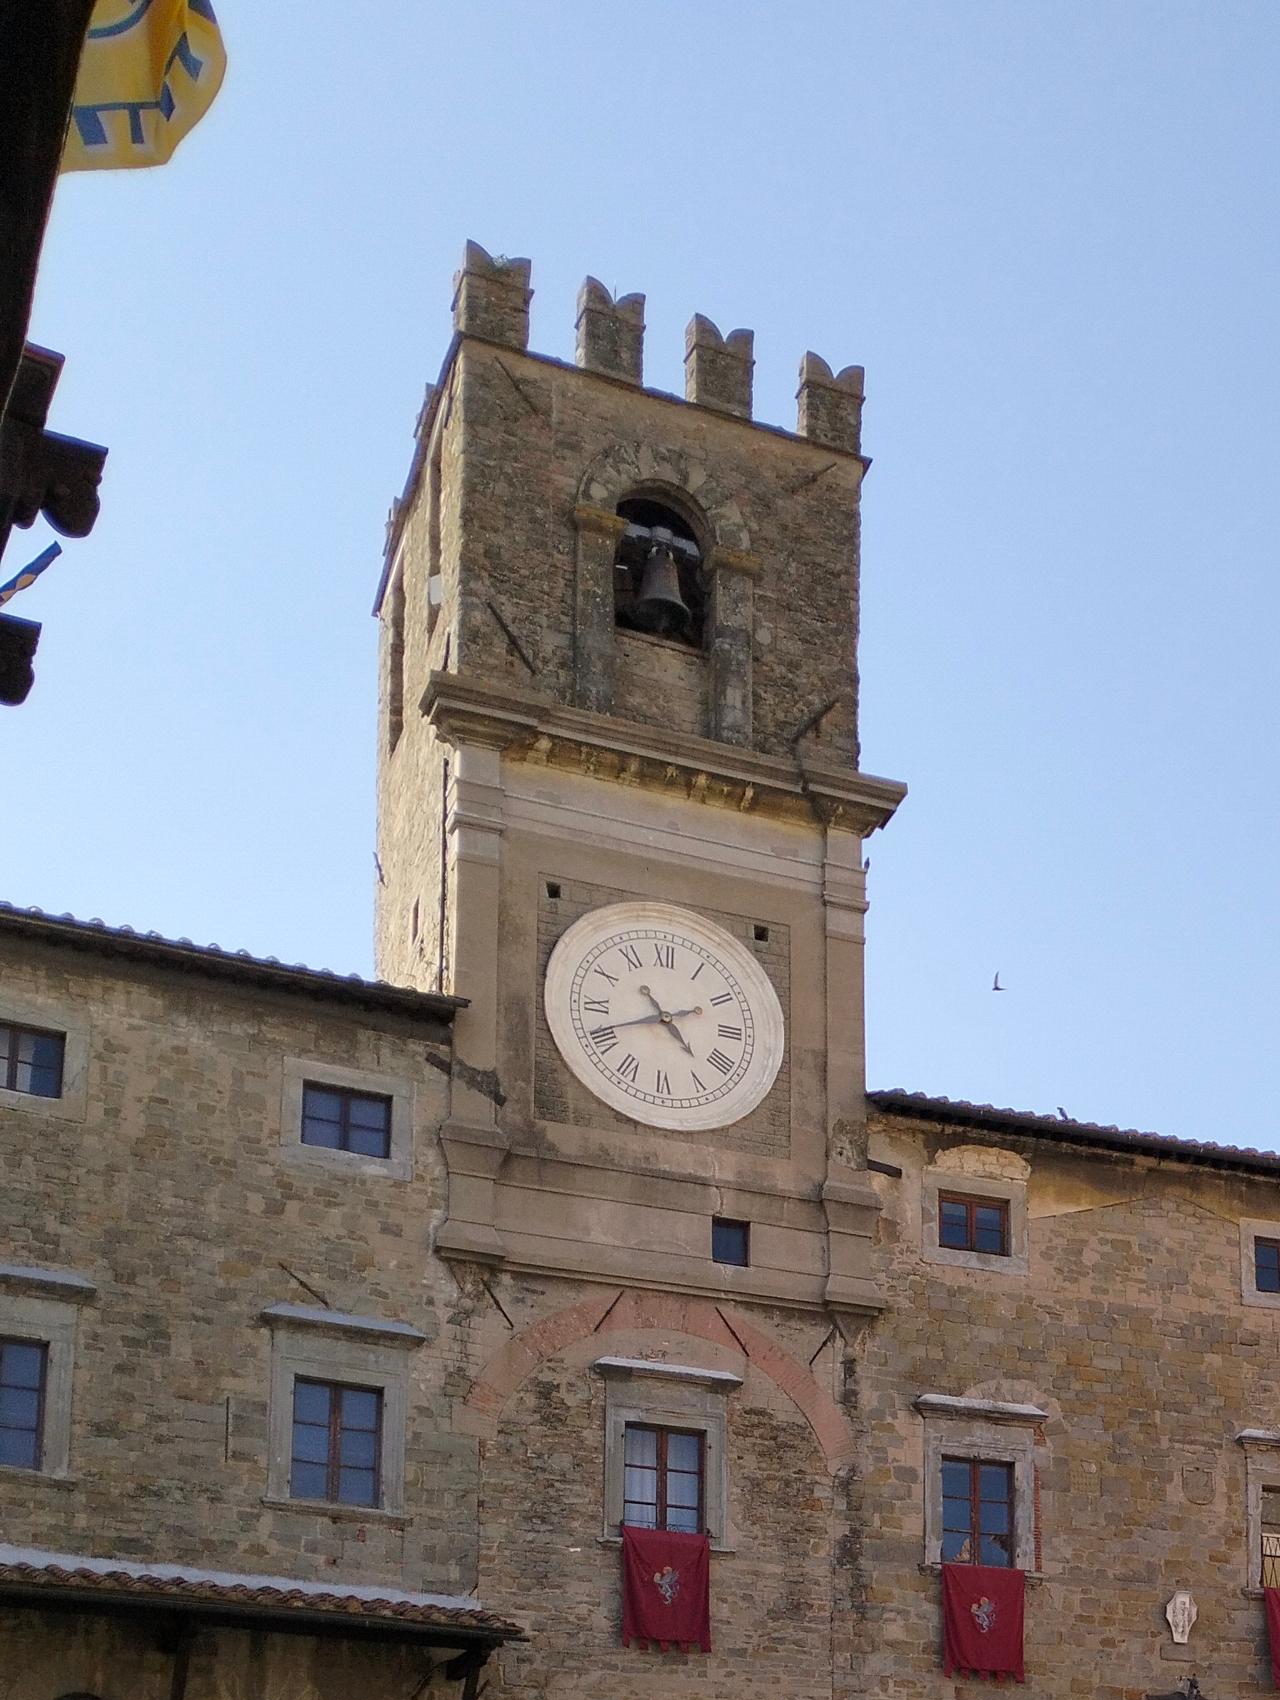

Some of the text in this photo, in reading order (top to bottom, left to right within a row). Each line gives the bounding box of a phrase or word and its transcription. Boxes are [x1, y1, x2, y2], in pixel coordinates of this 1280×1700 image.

[618, 944, 643, 972] XI
[653, 943, 675, 970] XII
[594, 964, 620, 988] X
[691, 962, 704, 981] I
[584, 994, 610, 1015] IX
[709, 992, 733, 1007] II
[718, 1024, 742, 1041] III
[617, 1053, 640, 1083] VII
[706, 1048, 735, 1076] IIII
[656, 1069, 671, 1095] VI
[691, 1069, 707, 1093] V
